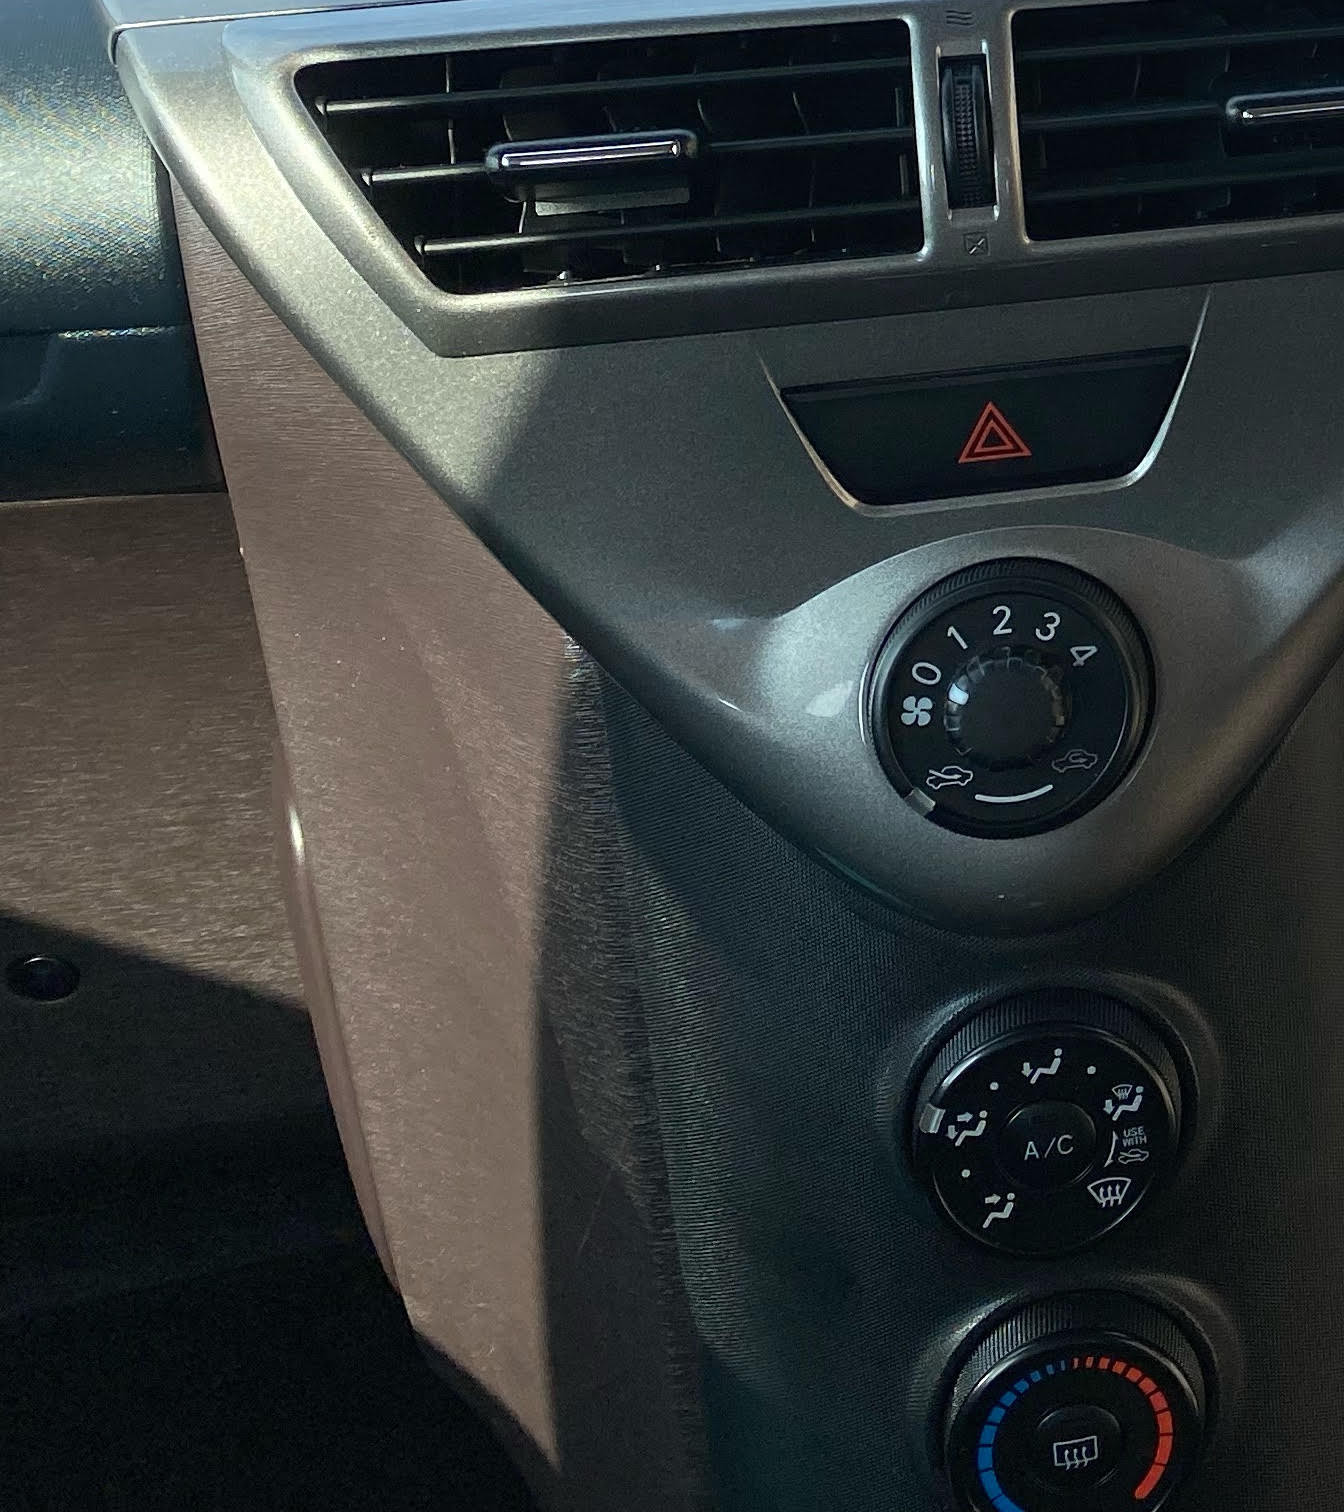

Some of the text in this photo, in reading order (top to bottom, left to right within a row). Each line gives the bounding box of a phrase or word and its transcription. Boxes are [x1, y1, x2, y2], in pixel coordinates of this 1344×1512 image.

[947, 625, 968, 649] 1
[992, 605, 1012, 635] 2
[1035, 612, 1061, 641] 3
[1069, 645, 1098, 667] 4
[1123, 1126, 1144, 1137] USE
[1024, 1135, 1073, 1160] A/C
[1122, 1136, 1147, 1147] WITH
